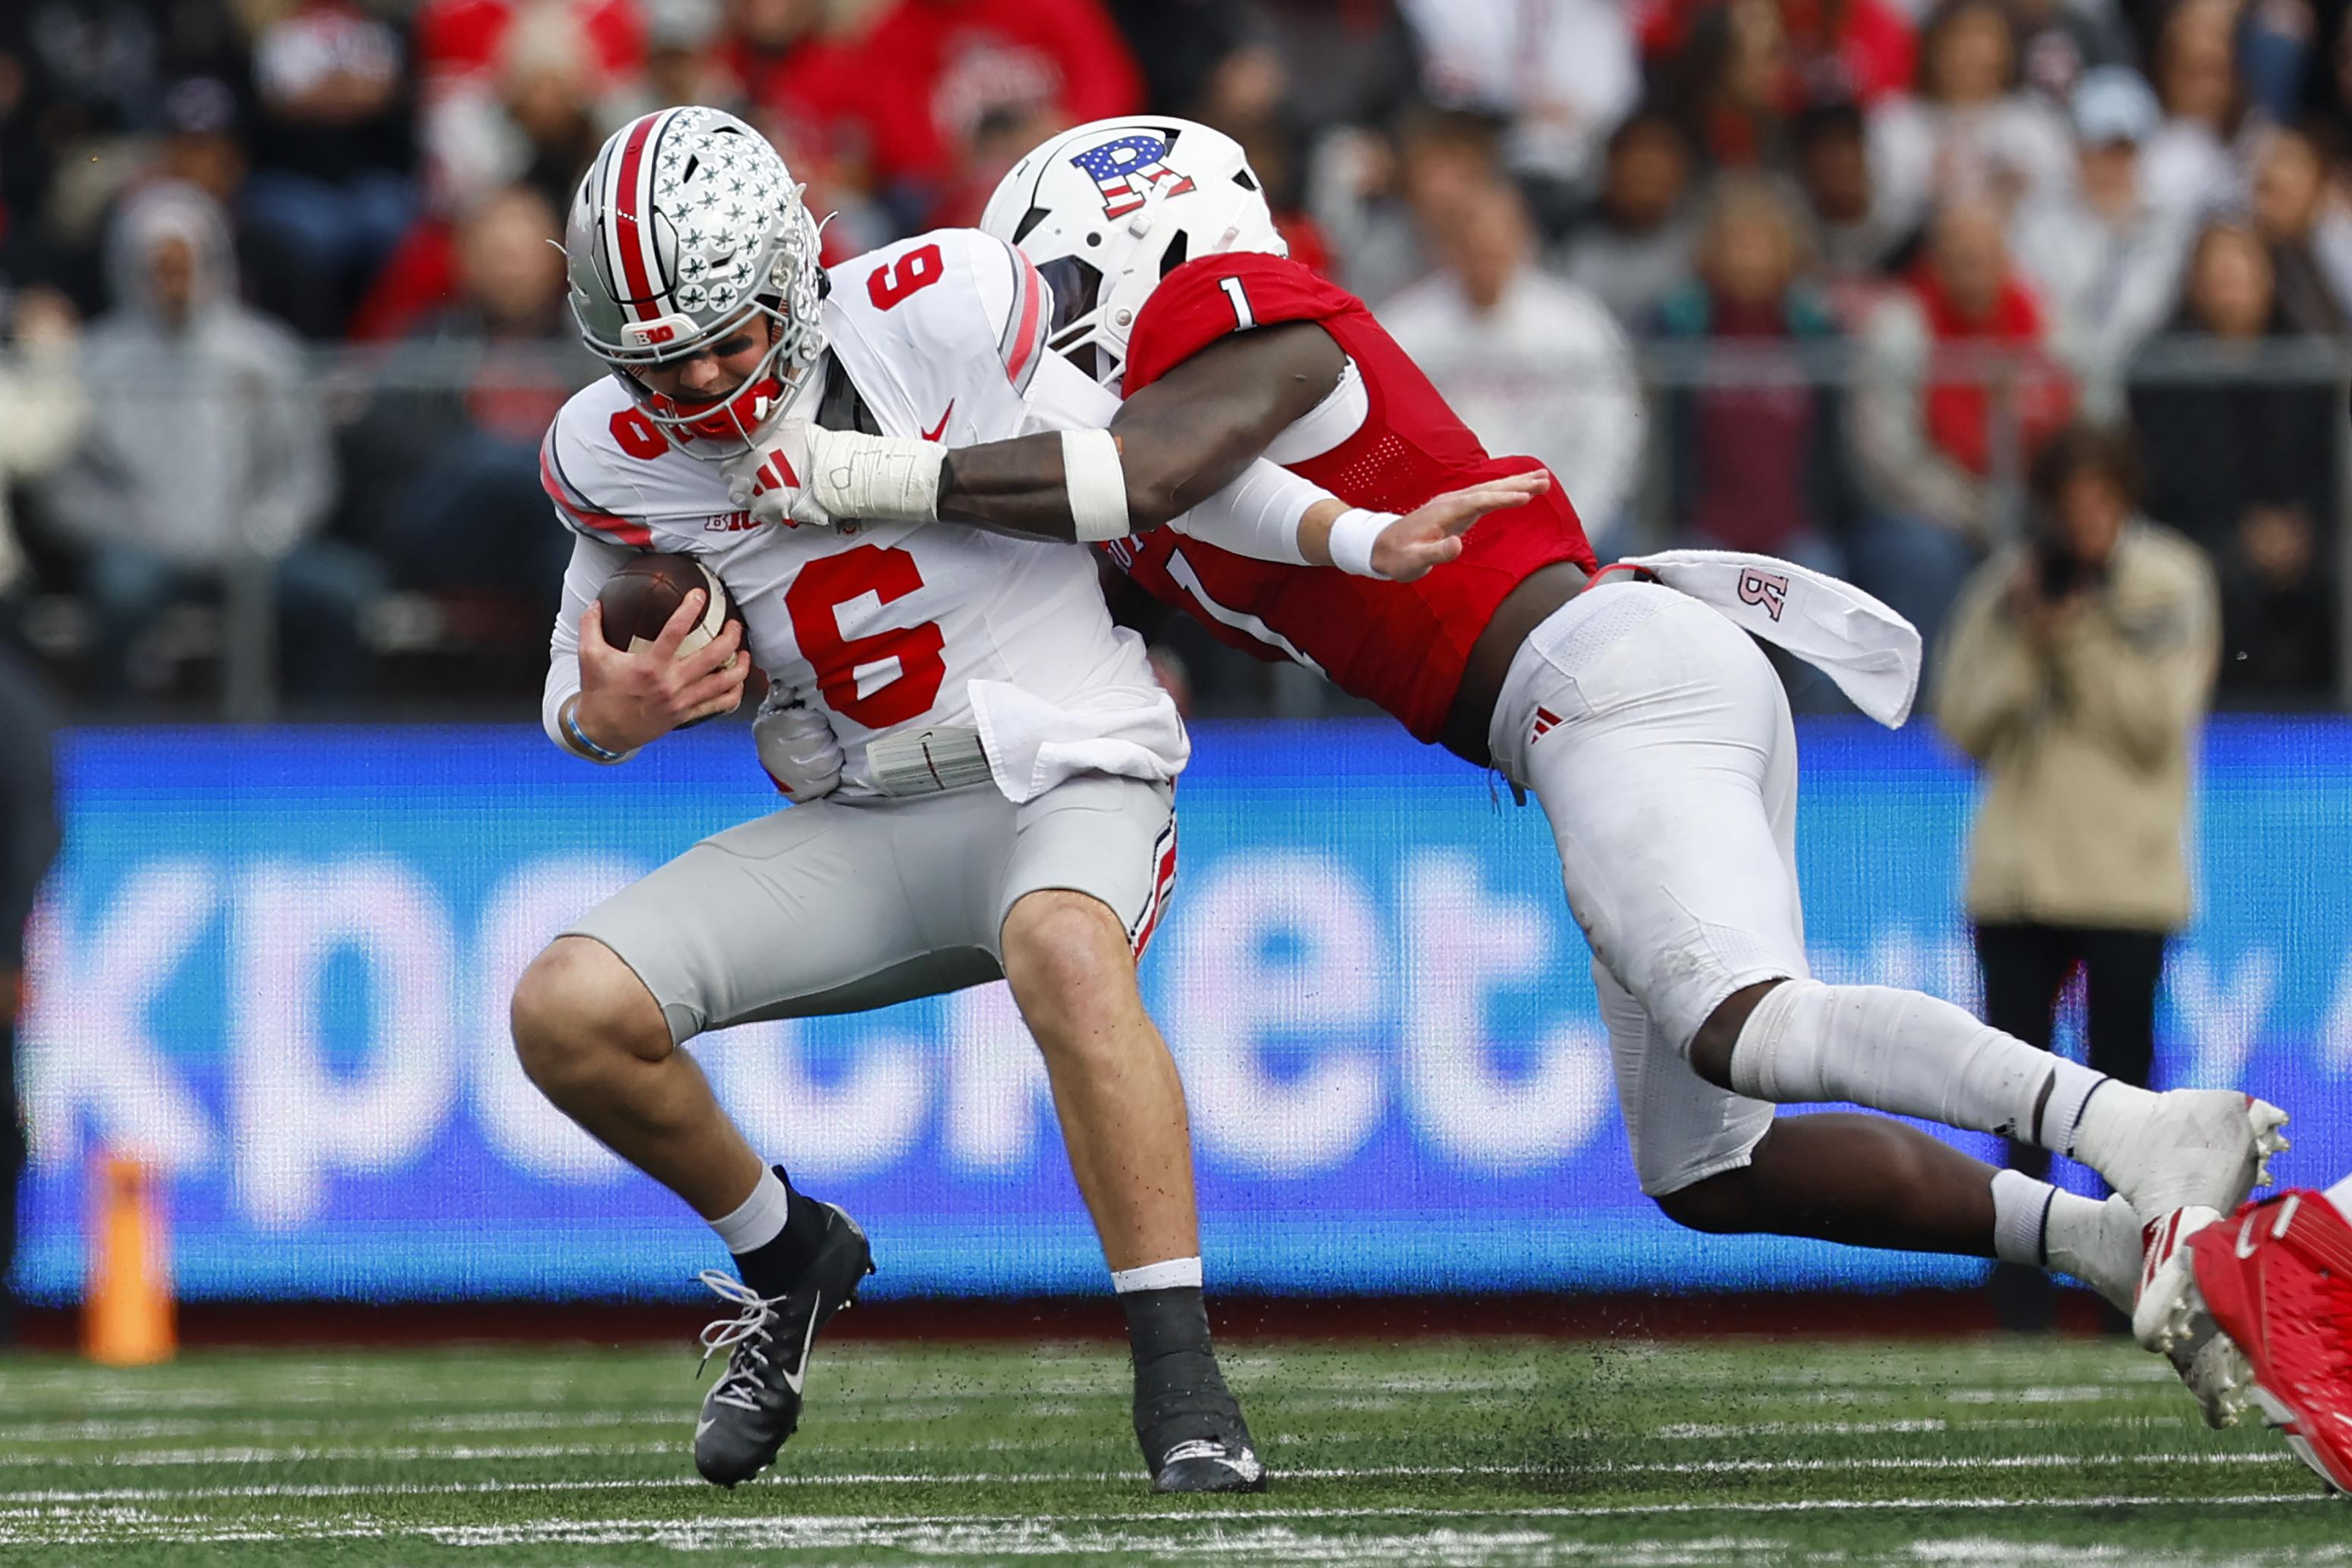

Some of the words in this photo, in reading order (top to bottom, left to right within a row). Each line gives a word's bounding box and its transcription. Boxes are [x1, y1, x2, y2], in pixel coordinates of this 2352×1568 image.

[1069, 135, 1197, 222] R
[866, 243, 944, 312] 6
[1218, 276, 1258, 332] 1
[1165, 546, 1330, 682] 1
[1737, 568, 1790, 623] R
[784, 543, 947, 730] 6
